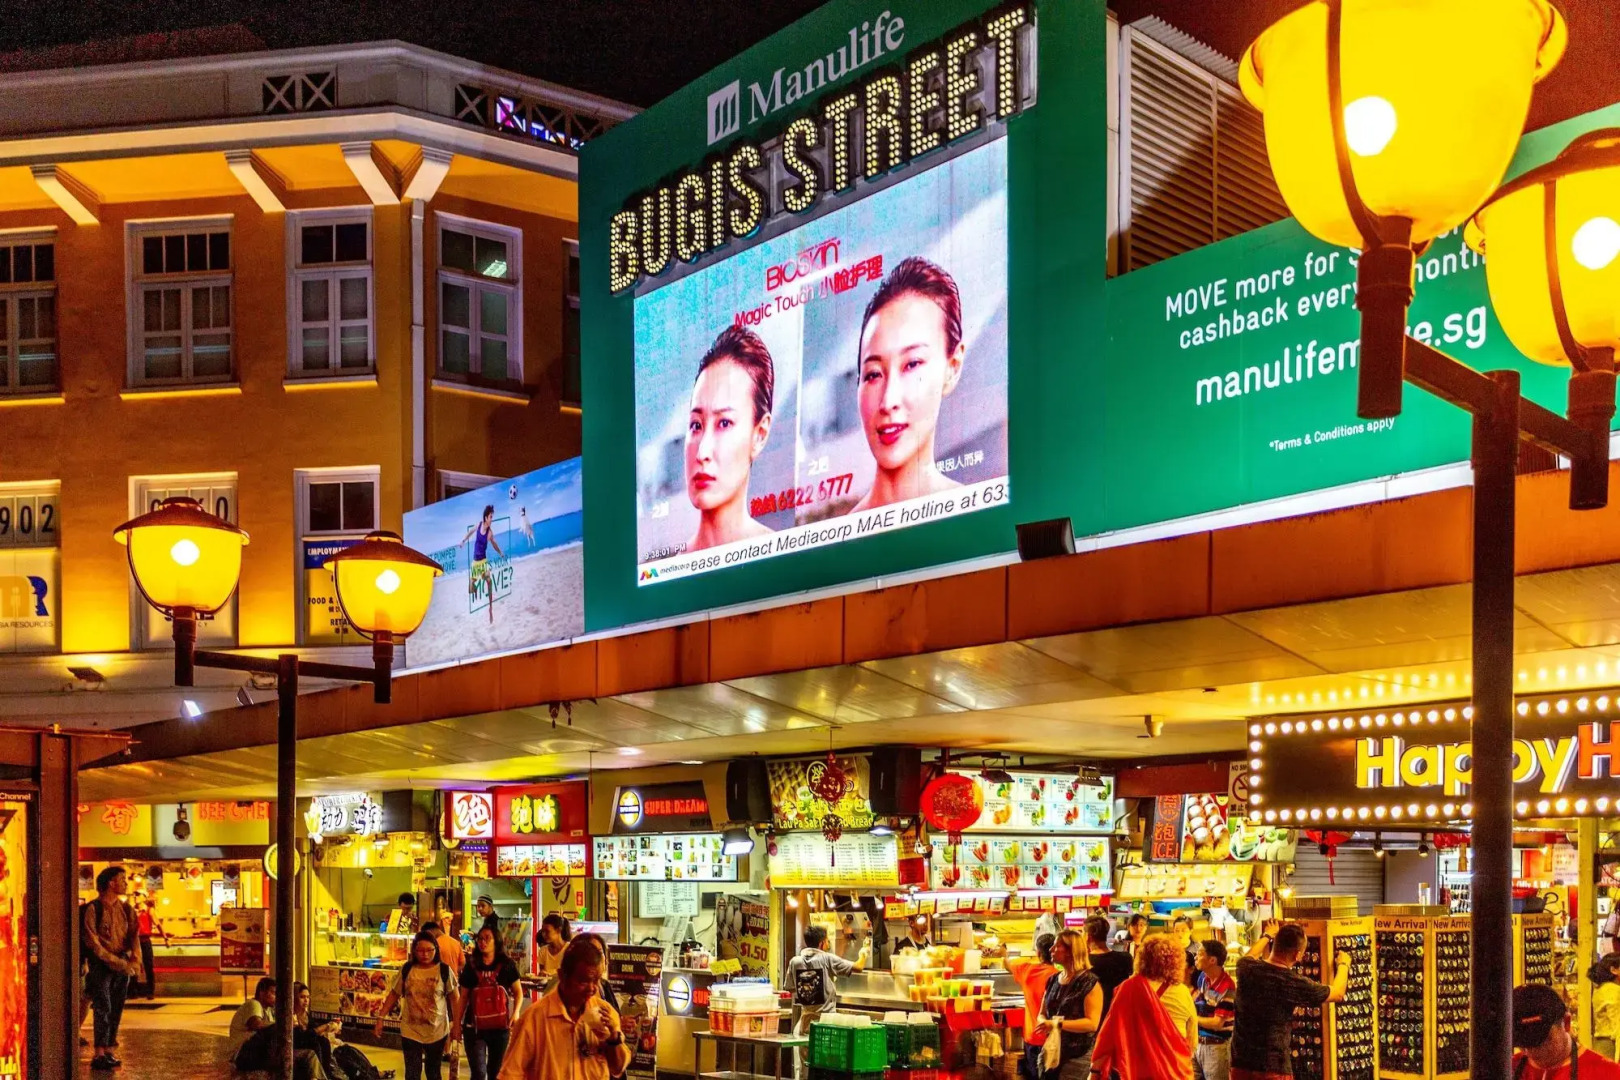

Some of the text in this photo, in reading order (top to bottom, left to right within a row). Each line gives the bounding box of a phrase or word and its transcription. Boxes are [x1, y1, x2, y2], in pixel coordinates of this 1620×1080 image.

[747, 10, 905, 125] Manulife
[609, 7, 1027, 293] BUGIS STREET
[1166, 278, 1228, 322] MOVE
[1235, 265, 1295, 301] more
[1304, 252, 1340, 280] for
[733, 285, 814, 327] Magic Touch
[1179, 296, 1289, 349] cashback
[1304, 433, 1312, 445] &
[1314, 423, 1364, 443] Conditions
[1366, 416, 1395, 433] apply
[778, 484, 813, 511] 6222
[817, 473, 854, 501] 6777
[724, 540, 772, 564] contact
[776, 522, 852, 552] Mediacorp
[857, 509, 896, 534] MAE
[900, 498, 955, 524] hotline
[960, 490, 978, 509] at
[674, 542, 687, 554] PM
[659, 562, 690, 575] mediacorp
[472, 566, 514, 603] MOVE?
[307, 596, 327, 605] FOOD
[0, 792, 31, 801] Channel
[644, 800, 672, 815] SUPER
[230, 801, 270, 823] CHE
[1394, 918, 1428, 929] Arrival
[1433, 918, 1471, 928] New Arriva
[740, 941, 768, 962] $1.50
[692, 989, 710, 1005] SUP
